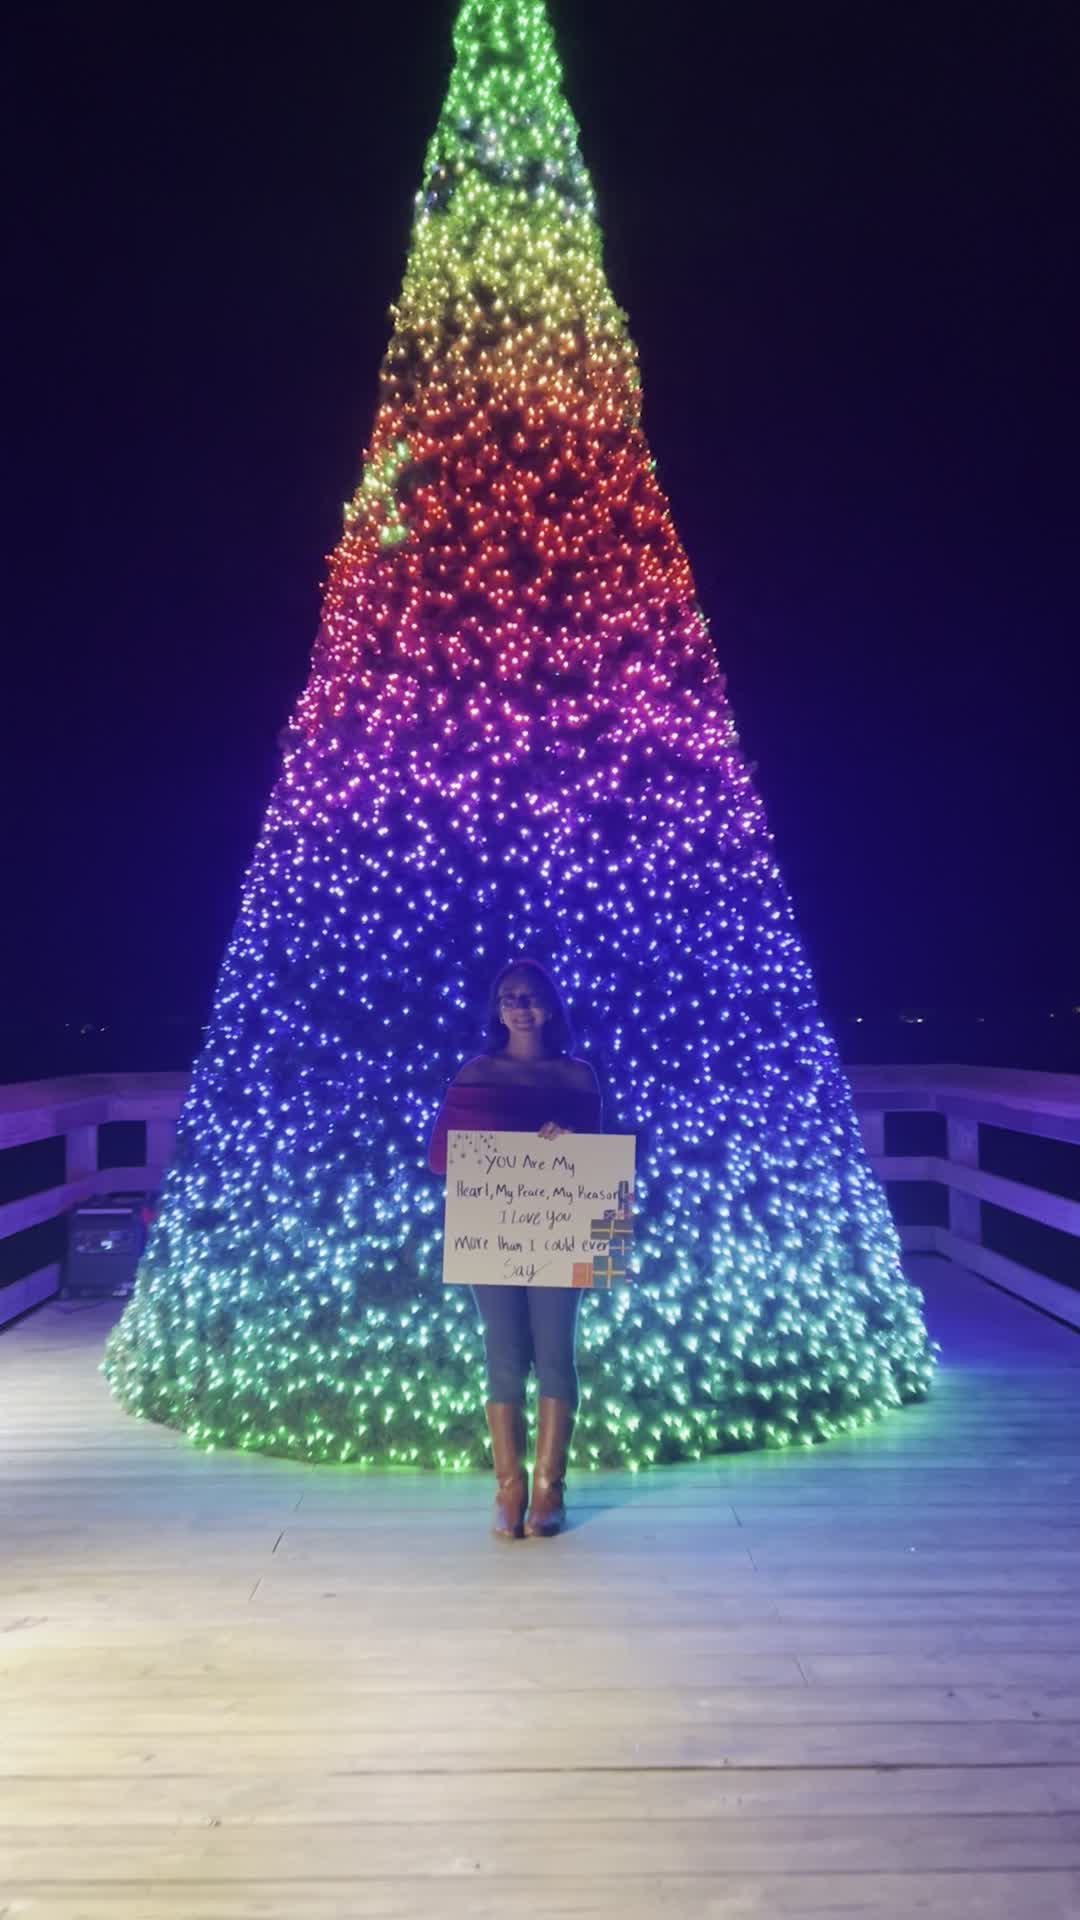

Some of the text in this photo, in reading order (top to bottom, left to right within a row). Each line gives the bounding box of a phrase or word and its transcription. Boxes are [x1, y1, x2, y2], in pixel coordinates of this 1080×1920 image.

[522, 1154, 545, 1170] Are
[551, 1156, 576, 1177] My
[495, 1183, 514, 1205] My
[551, 1185, 574, 1206] My
[499, 1210, 507, 1224] I
[510, 1210, 542, 1225] Love
[497, 1235, 523, 1252] than
[529, 1239, 536, 1252] I
[503, 1258, 540, 1282] Say
